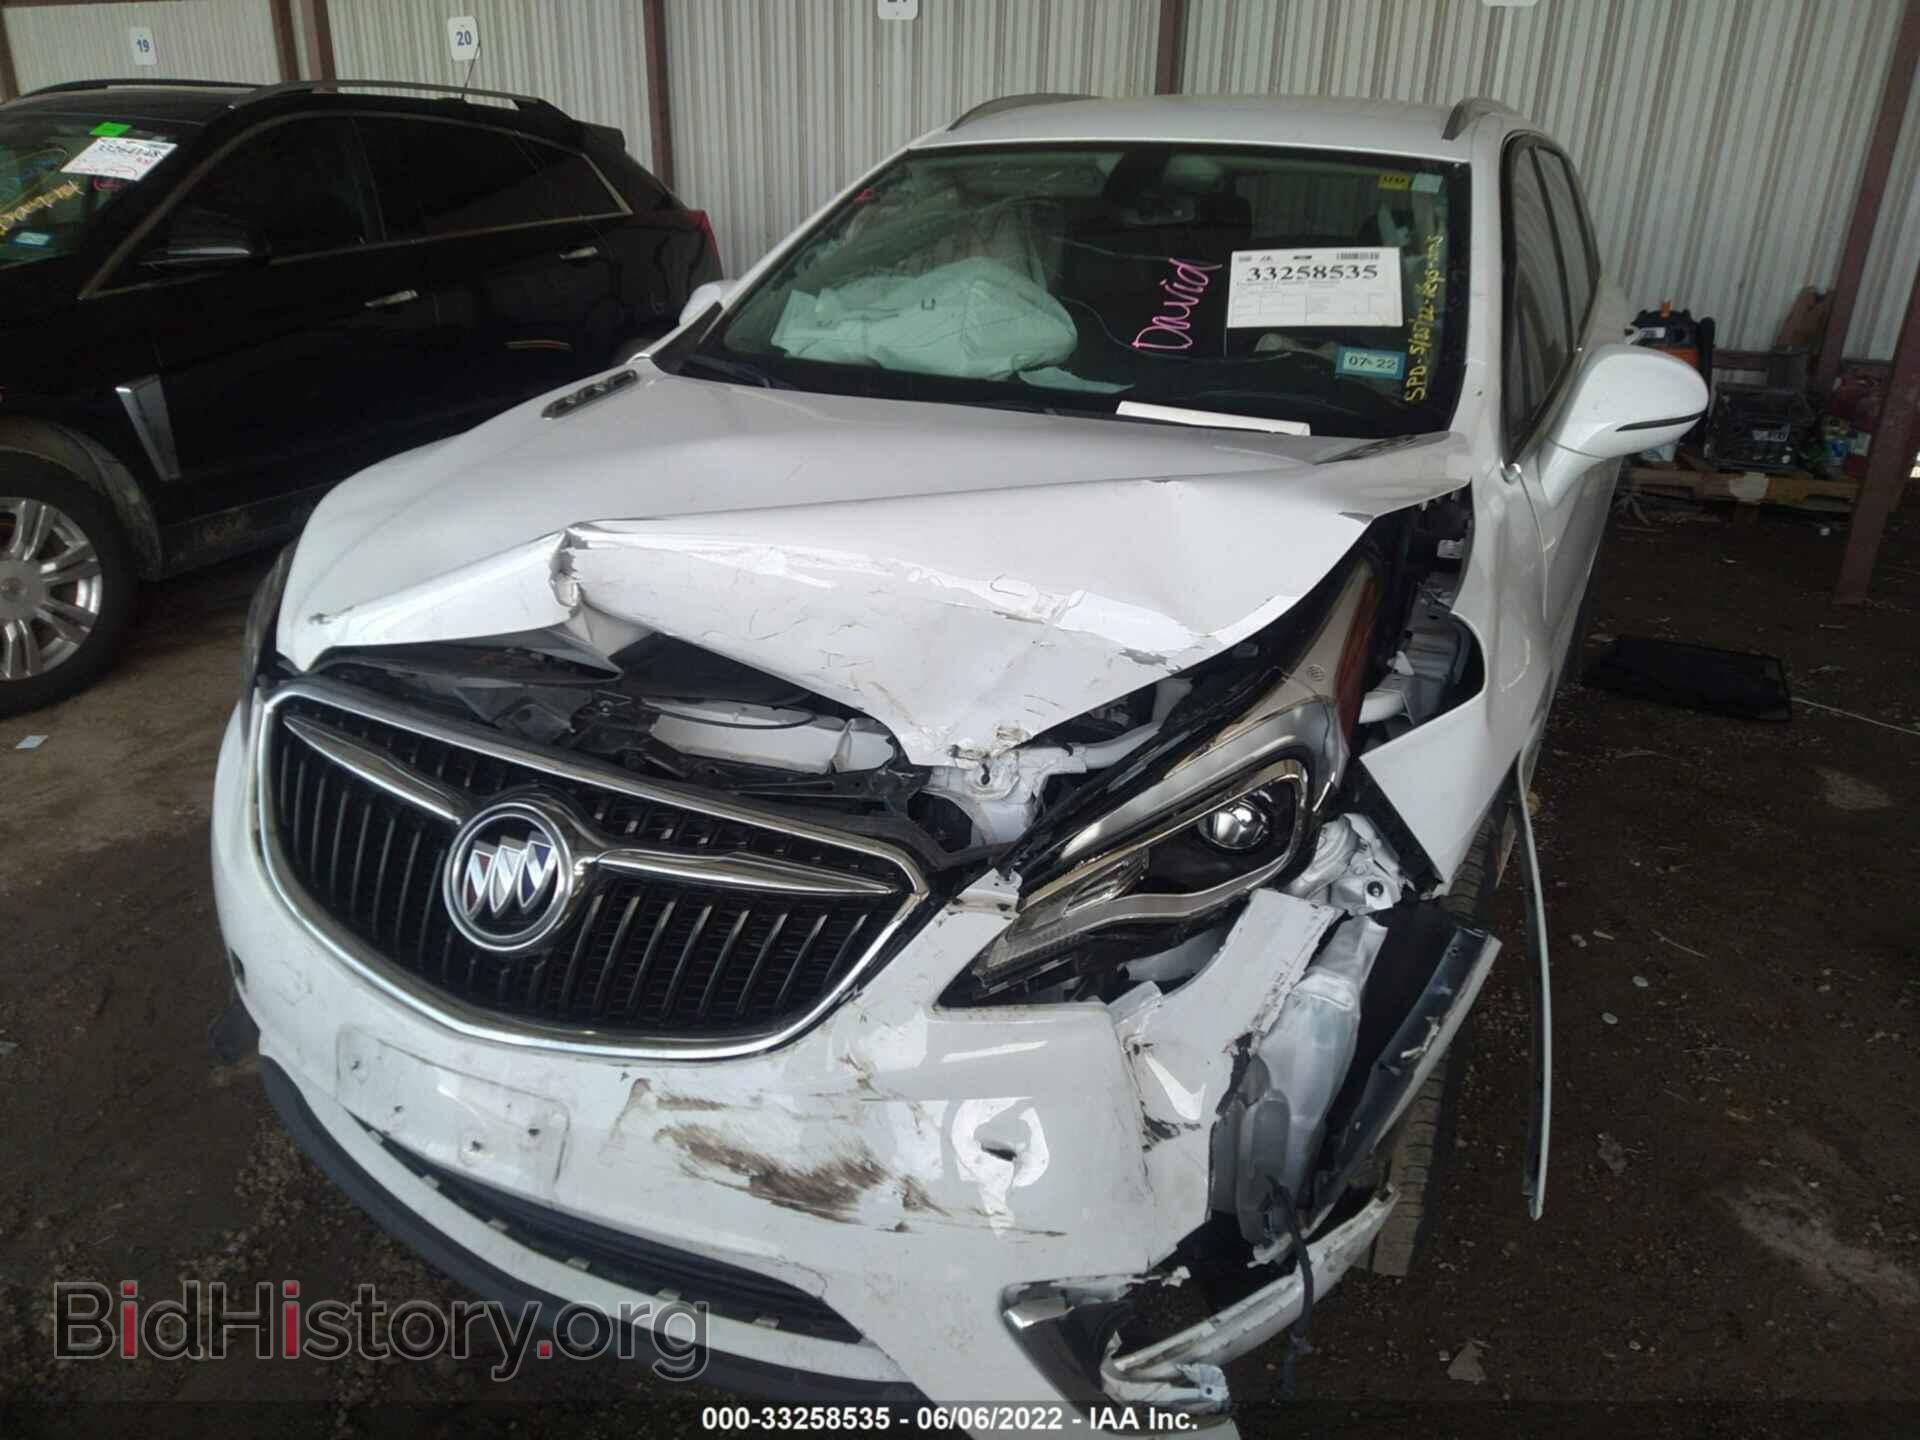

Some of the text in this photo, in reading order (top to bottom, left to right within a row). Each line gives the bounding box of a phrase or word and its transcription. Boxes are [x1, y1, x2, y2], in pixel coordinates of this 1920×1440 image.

[136, 39, 150, 53] 19
[456, 30, 472, 46] 20
[1246, 264, 1378, 281] 33258535
[1131, 257, 1223, 349] David
